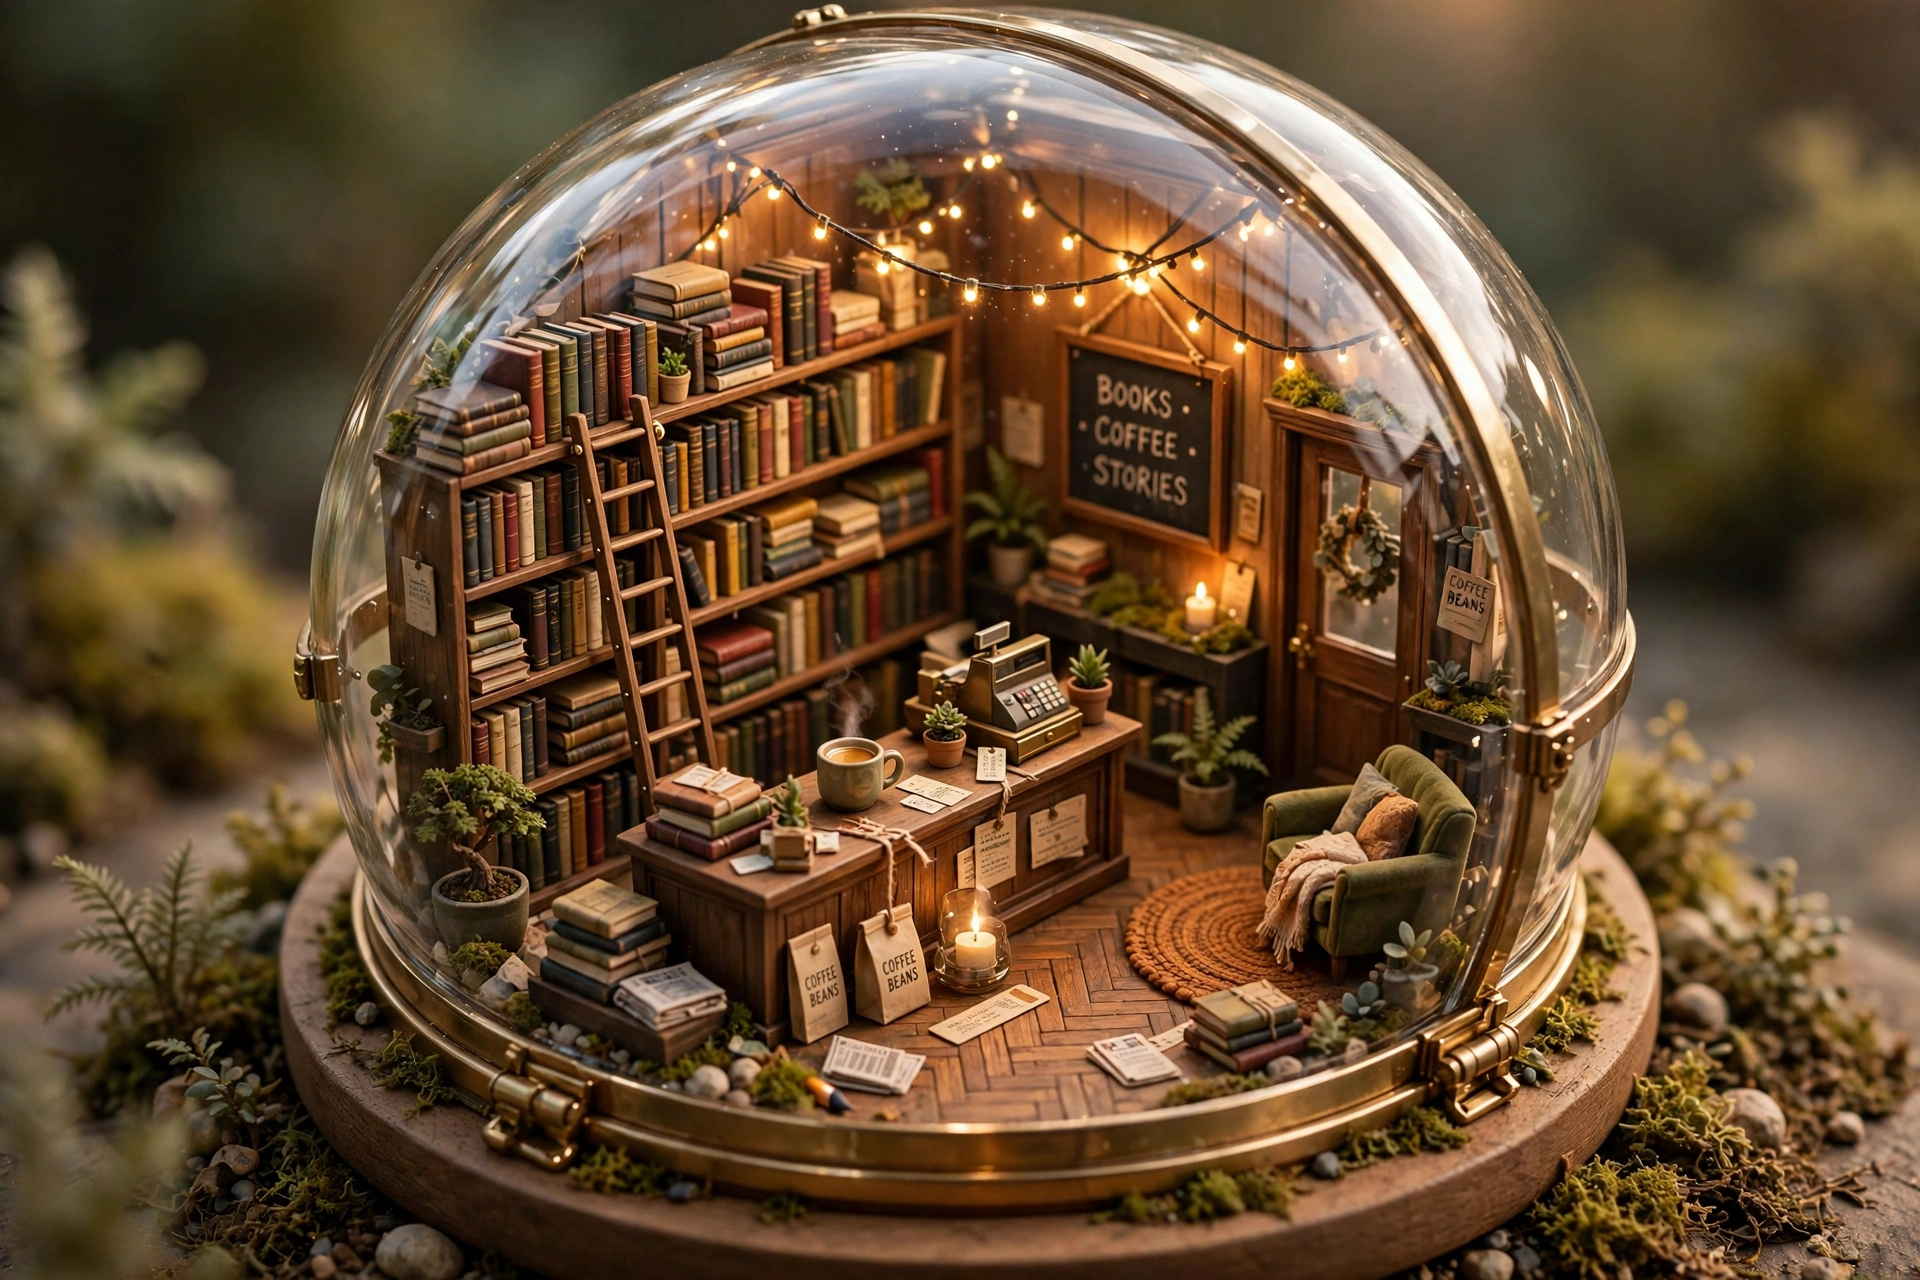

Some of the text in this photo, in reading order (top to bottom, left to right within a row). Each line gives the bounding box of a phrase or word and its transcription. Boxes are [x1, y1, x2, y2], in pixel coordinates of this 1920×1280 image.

[1096, 374, 1172, 419] BOOKS
[1094, 415, 1178, 460] COFFEE
[1093, 454, 1188, 506] STORIES
[1449, 574, 1489, 600] COFFEE
[1447, 590, 1485, 614] BEANS
[882, 949, 917, 975] COFFEE
[804, 964, 837, 990] COFFEE
[887, 967, 919, 993] BEANS
[809, 982, 839, 1008] BEANS
